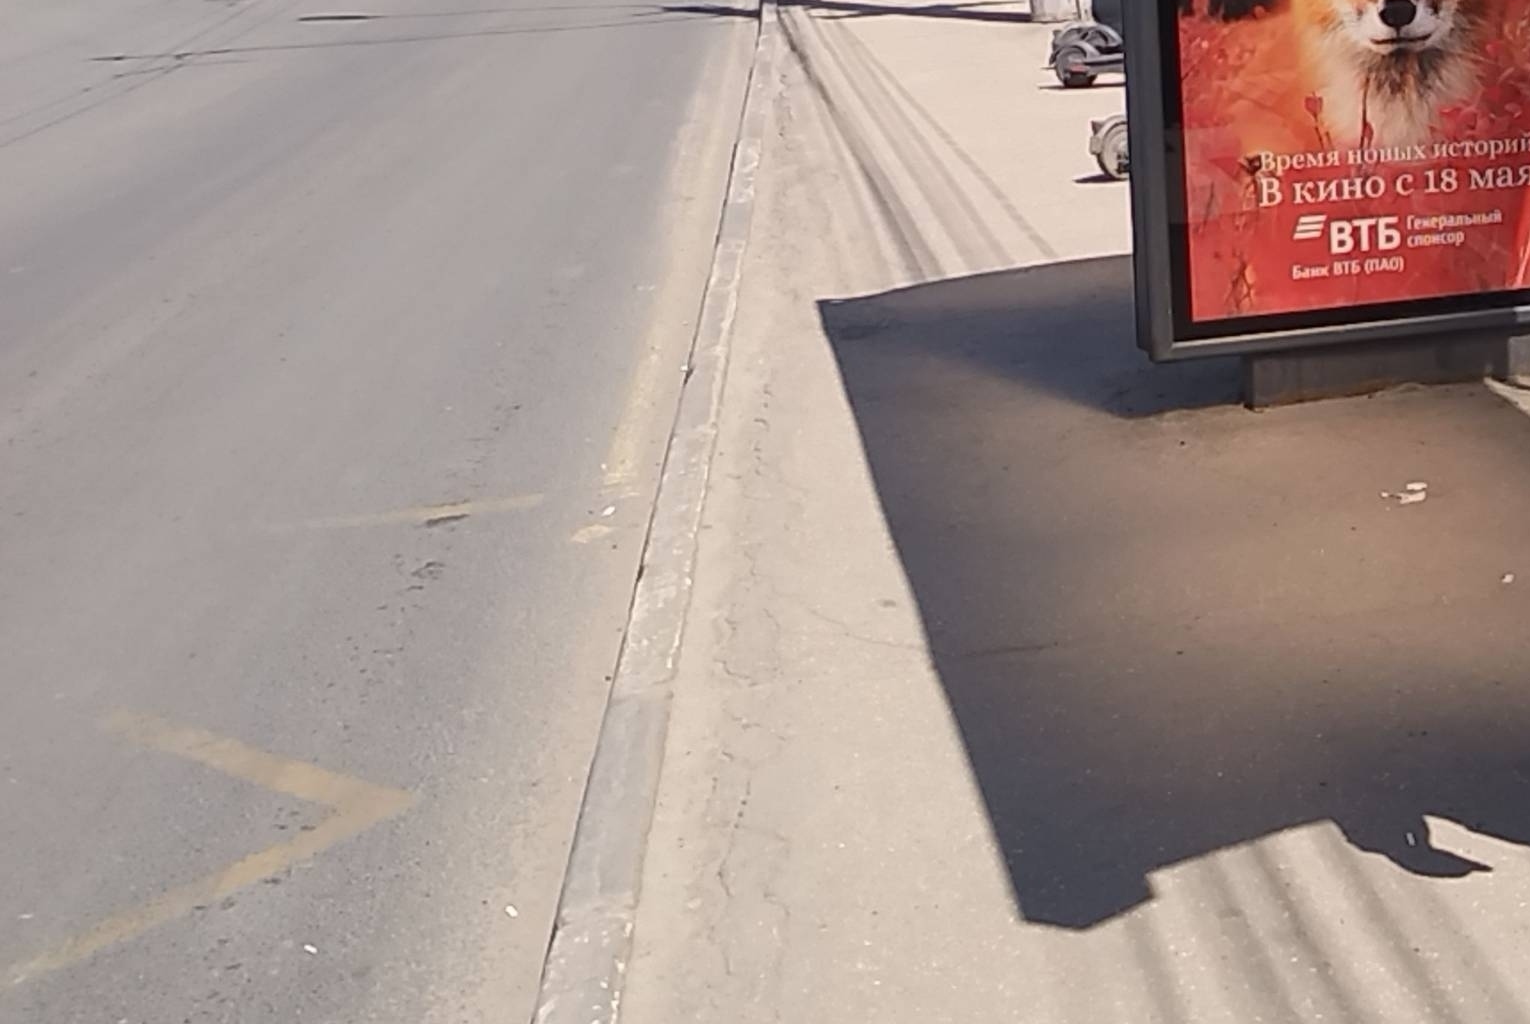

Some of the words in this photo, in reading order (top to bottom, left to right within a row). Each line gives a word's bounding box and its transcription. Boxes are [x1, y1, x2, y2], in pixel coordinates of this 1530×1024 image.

[1260, 150, 1342, 176] Время
[1347, 145, 1427, 165] новых
[1259, 177, 1283, 207] В
[1292, 175, 1386, 204] кино
[1395, 173, 1415, 196] с
[1423, 168, 1459, 194] 18
[1406, 209, 1503, 231] Генеральный
[1330, 216, 1401, 254] ВТБ
[1406, 231, 1465, 248] спонсор
[1292, 264, 1329, 280] Банк
[1333, 261, 1361, 275] ВТБ
[1363, 255, 1405, 275] (ПАО)
